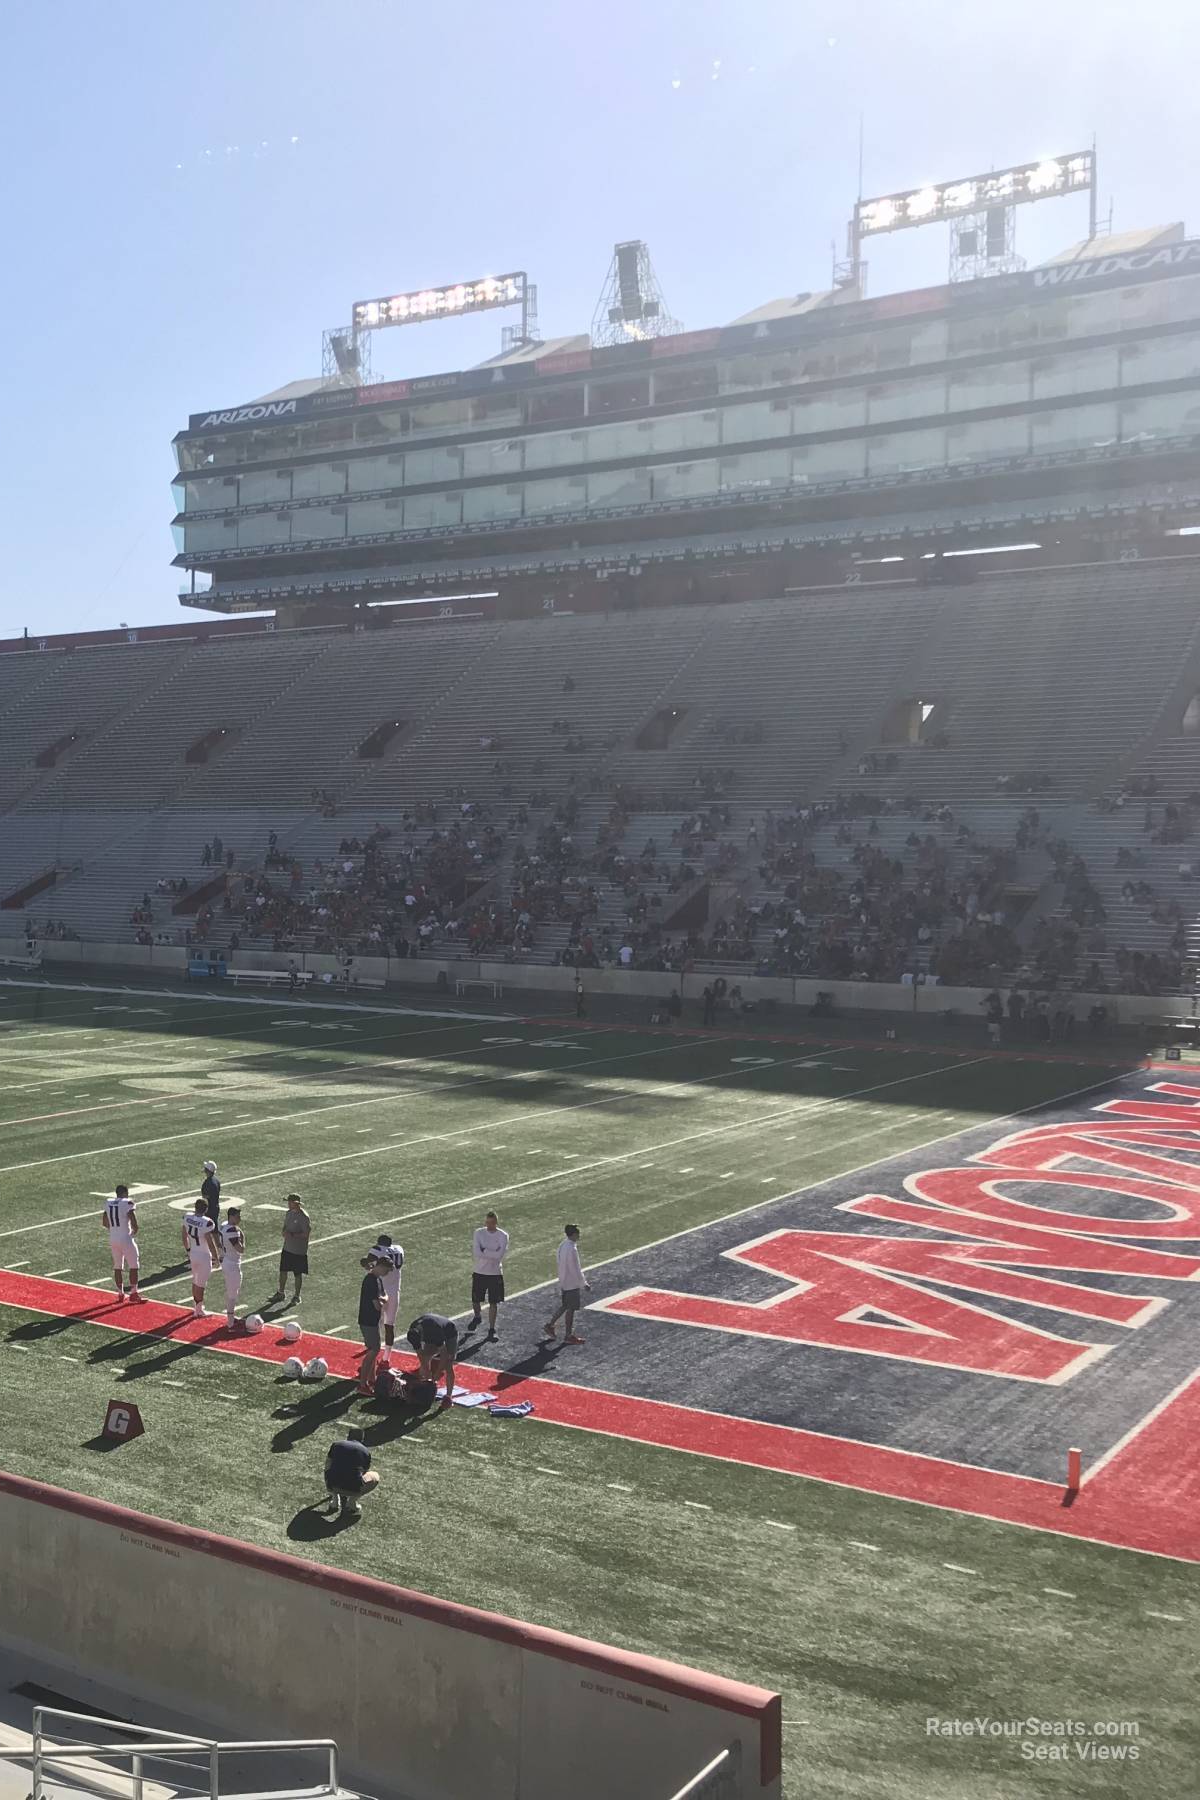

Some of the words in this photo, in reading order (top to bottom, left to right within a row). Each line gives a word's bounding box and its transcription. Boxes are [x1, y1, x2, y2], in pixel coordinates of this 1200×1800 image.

[200, 401, 297, 427] ARIZONA
[439, 607, 452, 617] 20
[108, 1205, 121, 1228] 11
[187, 1225, 200, 1247] 4
[107, 1408, 130, 1435] G
